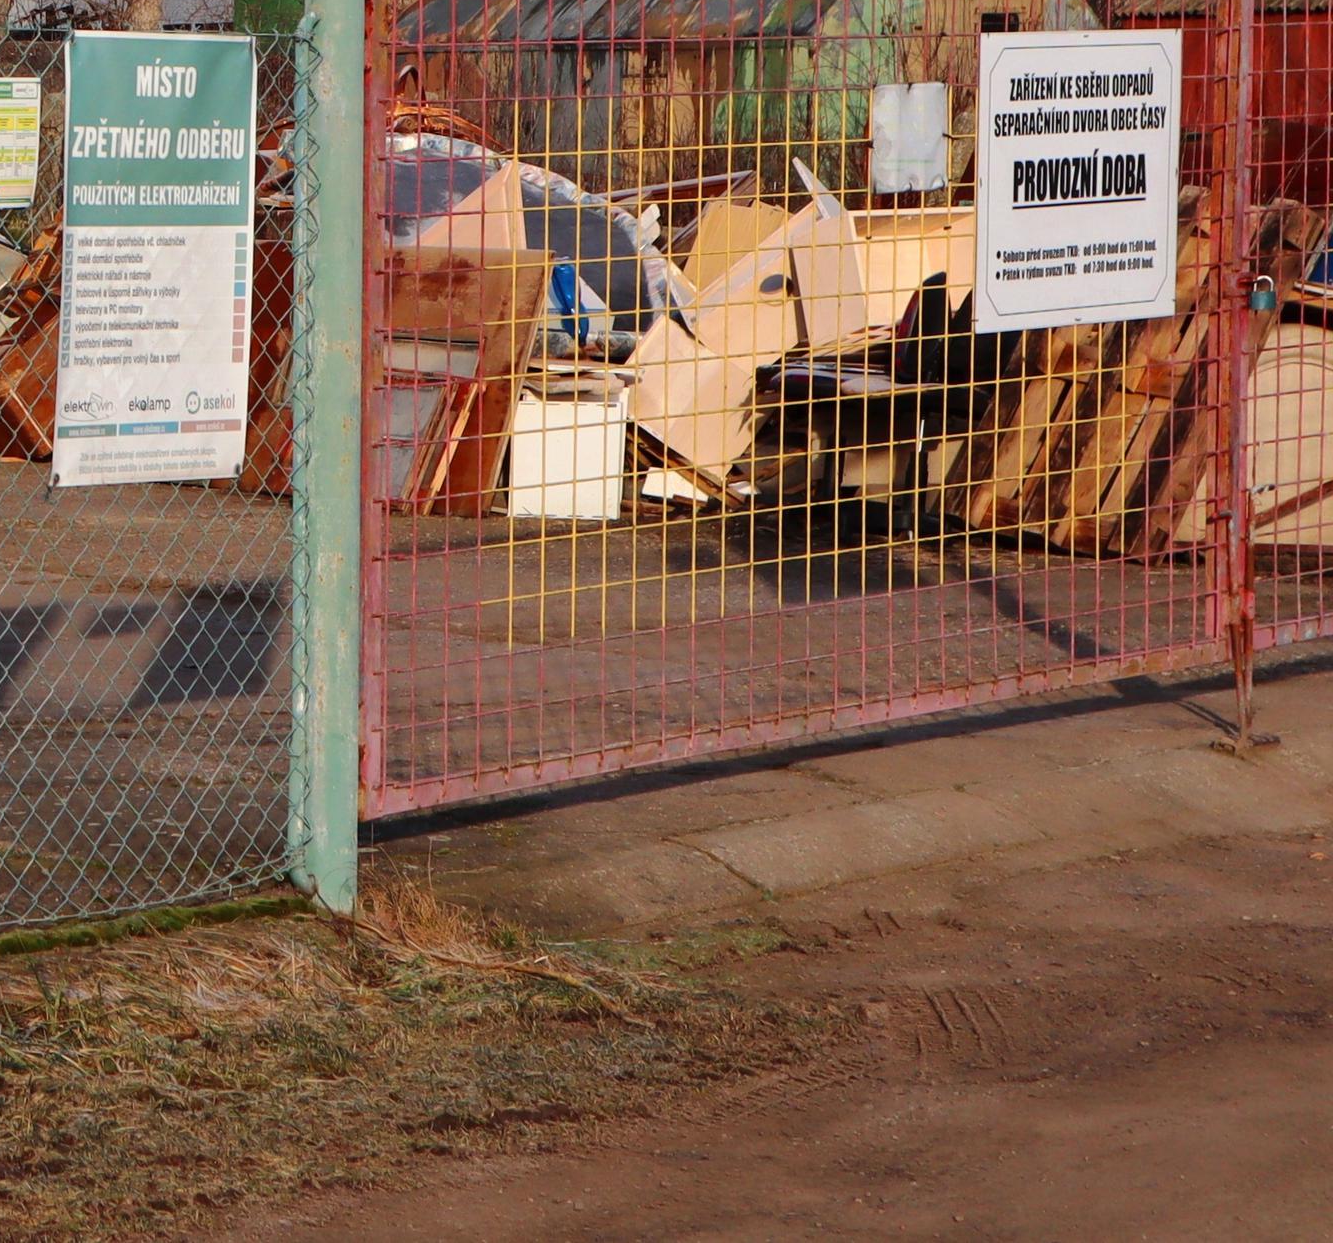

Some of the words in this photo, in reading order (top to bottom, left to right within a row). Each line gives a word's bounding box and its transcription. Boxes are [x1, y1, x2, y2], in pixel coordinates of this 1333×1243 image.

[136, 58, 197, 98] MÍSTO
[1009, 72, 1058, 101] ZAŘÍZENÍ
[1060, 76, 1072, 99] KE
[1075, 70, 1109, 99] SBĚRU
[1112, 67, 1153, 97] ODPADŮ
[994, 107, 1070, 137] SEPARAČNÍHO
[1073, 109, 1108, 133] DVORA
[1111, 108, 1138, 131] OBCE
[1140, 103, 1166, 130] ČASY
[72, 117, 171, 159] ZPĚTNÉHO
[176, 120, 245, 160] ODBĚRU
[1013, 148, 1099, 203] PROVOZNÍ
[1101, 154, 1146, 197] DOBA
[72, 180, 136, 205] POUŽITÝCH
[139, 180, 241, 205] ELEKTROZAŘÍZENÍ
[1003, 250, 1025, 263] Sobota
[1026, 248, 1041, 263] před
[1083, 243, 1091, 256] od
[1107, 242, 1119, 254] hod
[1120, 242, 1128, 253] do
[1002, 268, 1020, 281] Pátek
[1083, 261, 1091, 274] od
[1106, 259, 1118, 272] hod
[1118, 259, 1126, 271] do
[128, 395, 171, 415] ekolamp
[203, 394, 236, 410] asekol
